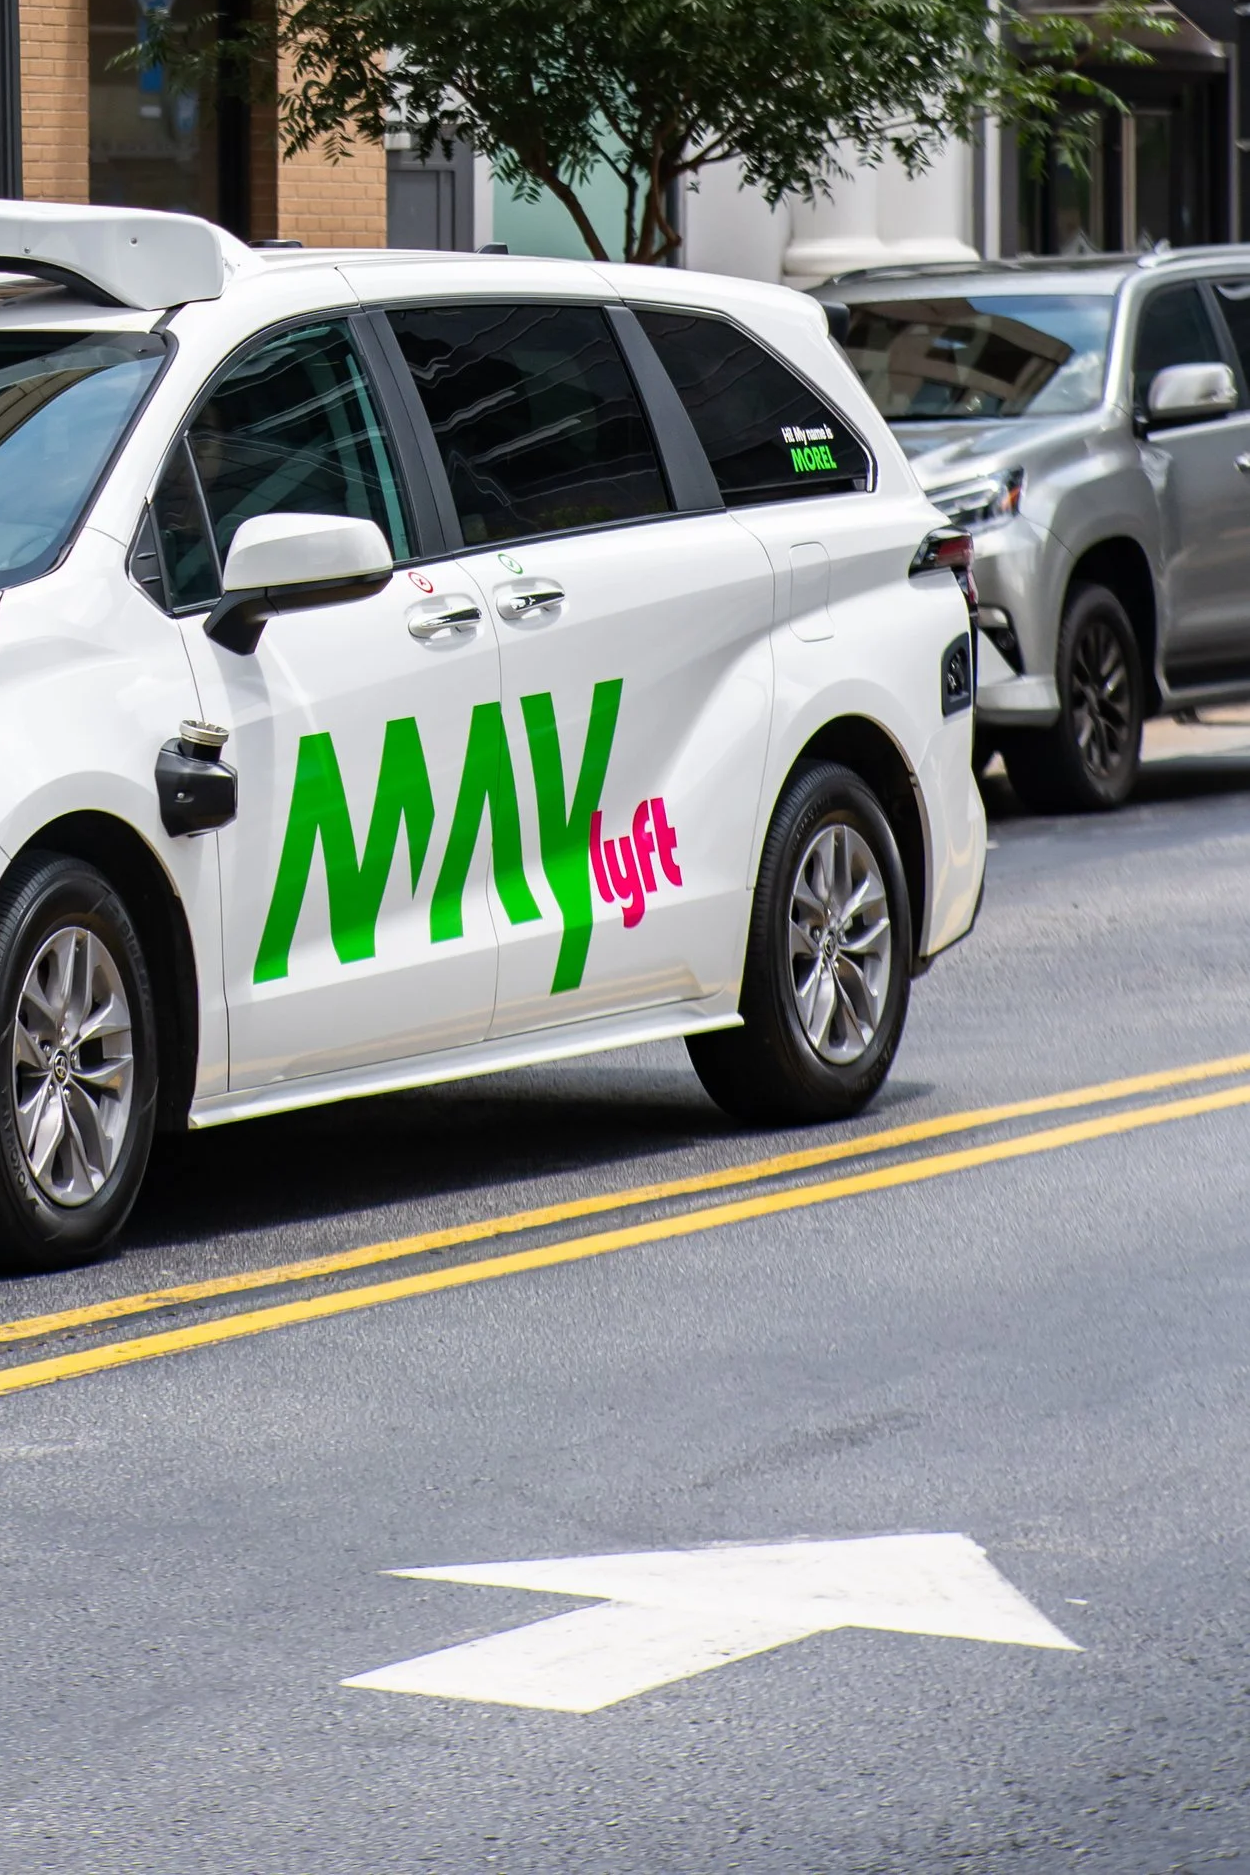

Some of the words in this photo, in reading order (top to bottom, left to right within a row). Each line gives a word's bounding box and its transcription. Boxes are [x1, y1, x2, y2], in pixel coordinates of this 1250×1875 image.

[791, 445, 837, 472] MOREL
[792, 425, 808, 446] My
[805, 428, 827, 441] name
[823, 423, 834, 440] is
[253, 678, 624, 996] MAY
[590, 797, 683, 929] lyft
